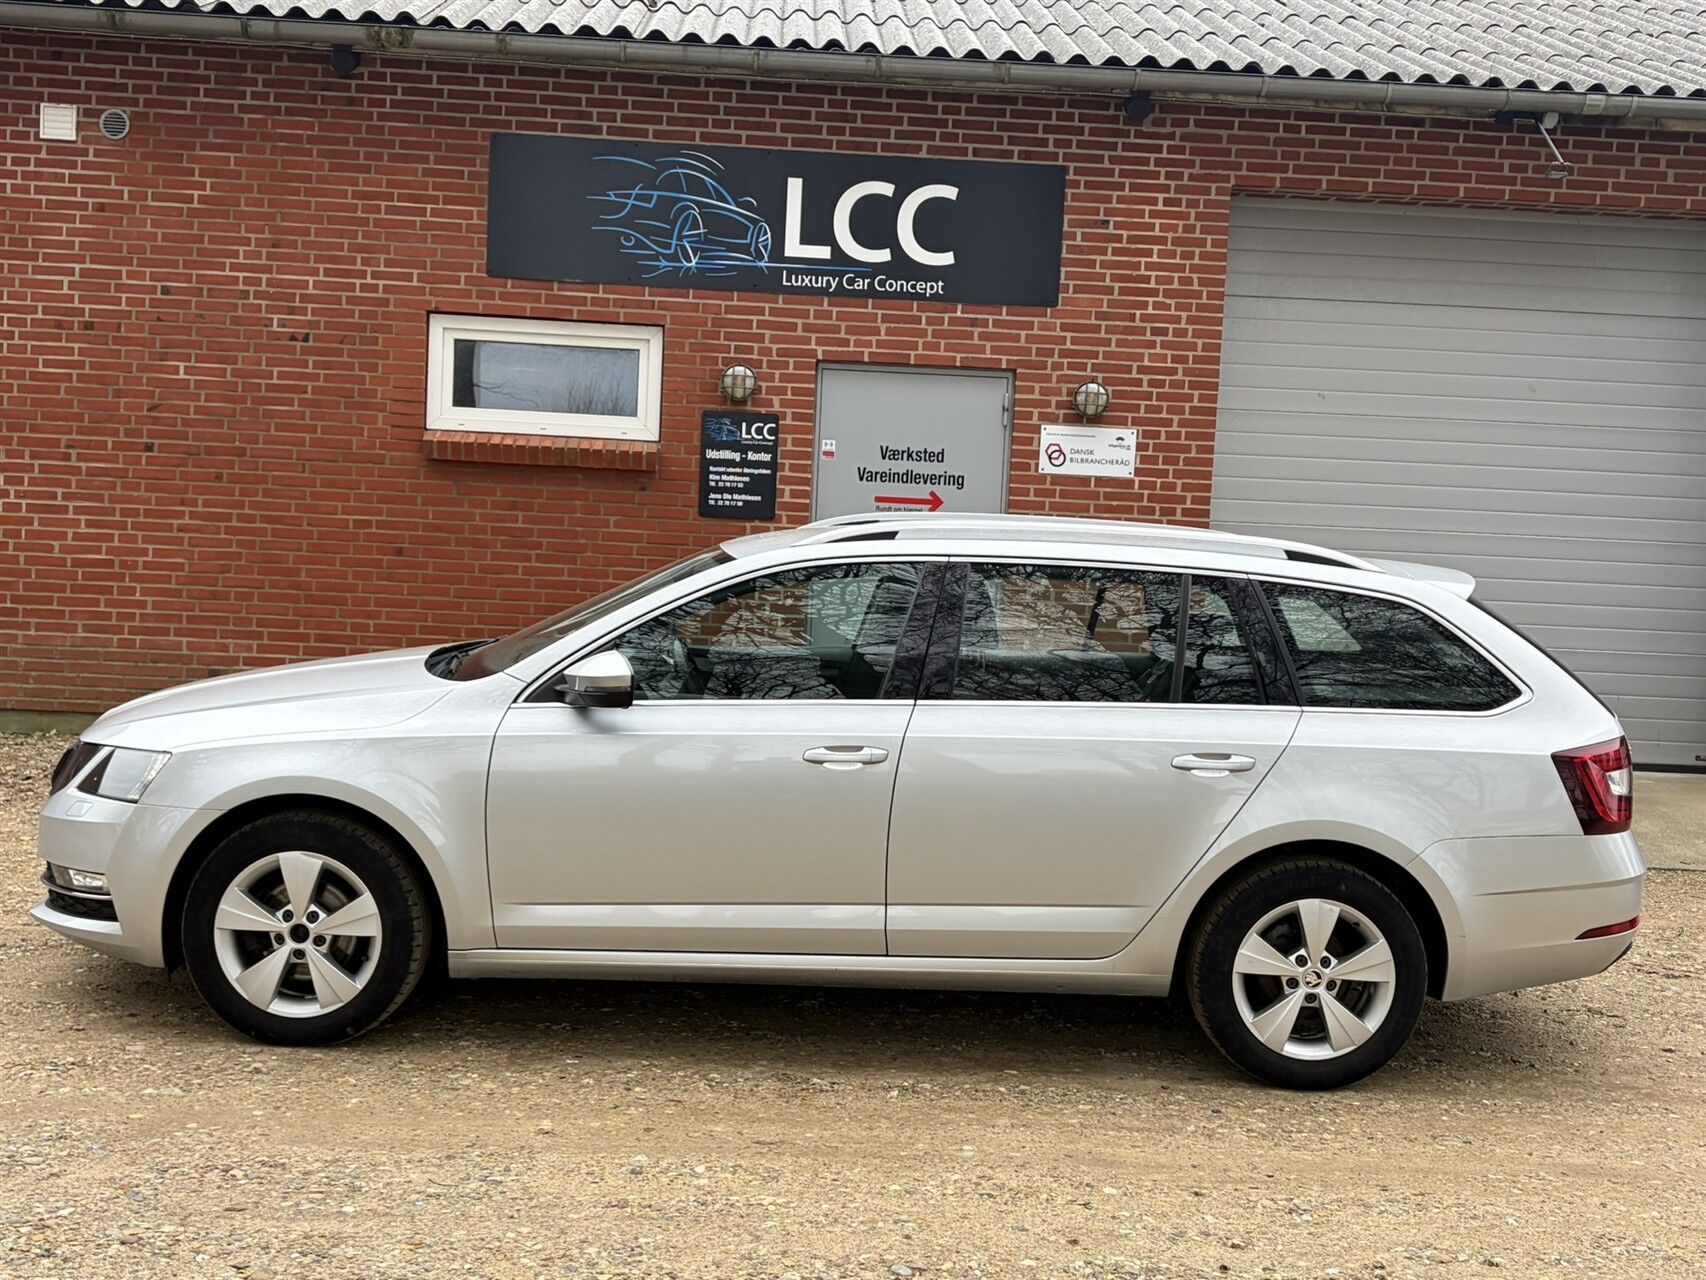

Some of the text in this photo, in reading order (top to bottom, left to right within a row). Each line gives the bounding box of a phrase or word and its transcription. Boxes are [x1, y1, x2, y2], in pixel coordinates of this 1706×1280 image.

[784, 177, 959, 266] LCC
[782, 270, 945, 297] Luxury Car Concept
[741, 422, 776, 440] LCC
[705, 449, 740, 462] Udstilling
[747, 451, 772, 462] Kontor
[879, 445, 945, 463] Værksted
[1069, 448, 1095, 456] DANSK
[1069, 457, 1131, 466] BILBRANCHERÅD
[857, 467, 965, 490] Vareindlevering
